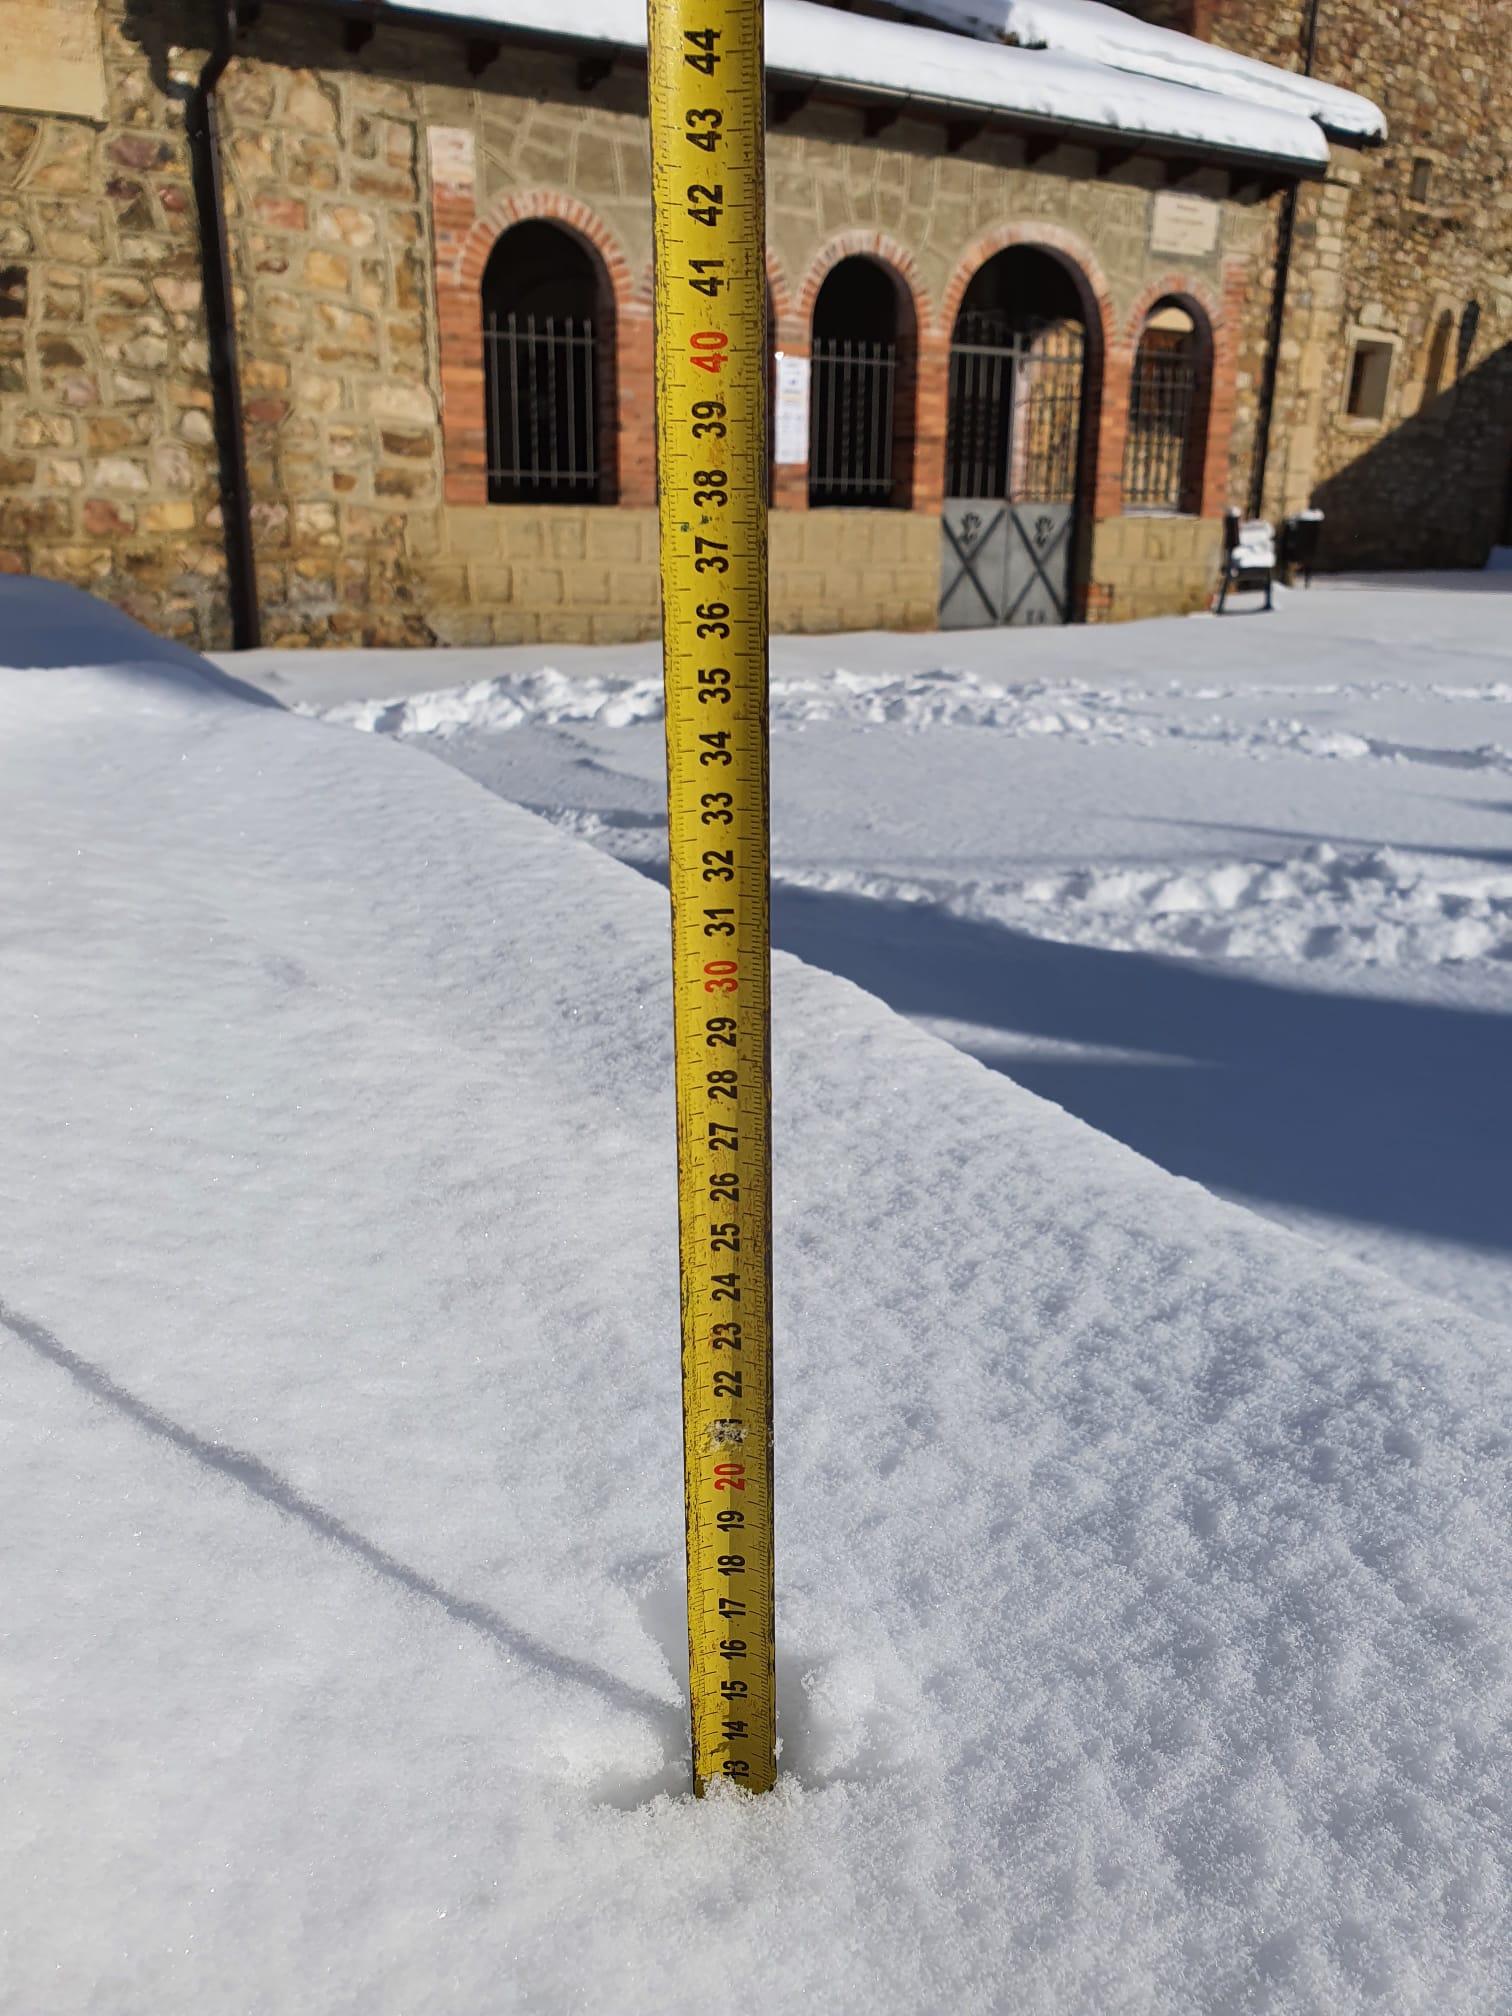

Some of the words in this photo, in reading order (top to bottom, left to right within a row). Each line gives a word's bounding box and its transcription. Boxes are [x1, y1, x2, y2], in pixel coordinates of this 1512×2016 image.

[685, 29, 721, 75] 44
[686, 109, 722, 152] 43
[688, 185, 722, 226] 42
[689, 260, 724, 296] 41
[690, 331, 728, 373] 40
[692, 401, 727, 439] 39
[693, 470, 727, 507] 38
[695, 536, 729, 573] 37
[696, 603, 730, 640] 36
[698, 668, 731, 705] 35
[699, 732, 732, 767] 34
[701, 793, 733, 826] 33
[703, 850, 734, 882] 32
[704, 908, 735, 937] 31
[704, 960, 738, 993] 30
[706, 1017, 737, 1048] 29
[707, 1070, 738, 1100] 28
[709, 1122, 739, 1151] 27
[710, 1172, 739, 1202] 26
[711, 1222, 740, 1252] 25
[711, 1273, 741, 1302] 24
[713, 1322, 742, 1351] 23
[714, 1371, 742, 1399] 22
[714, 1463, 746, 1491] 20
[717, 1510, 744, 1532] 19
[718, 1554, 745, 1576] 18
[719, 1597, 745, 1618] 17
[720, 1639, 746, 1661] 16
[721, 1680, 747, 1701] 15
[722, 1720, 748, 1741] 14
[723, 1760, 749, 1782] 13
